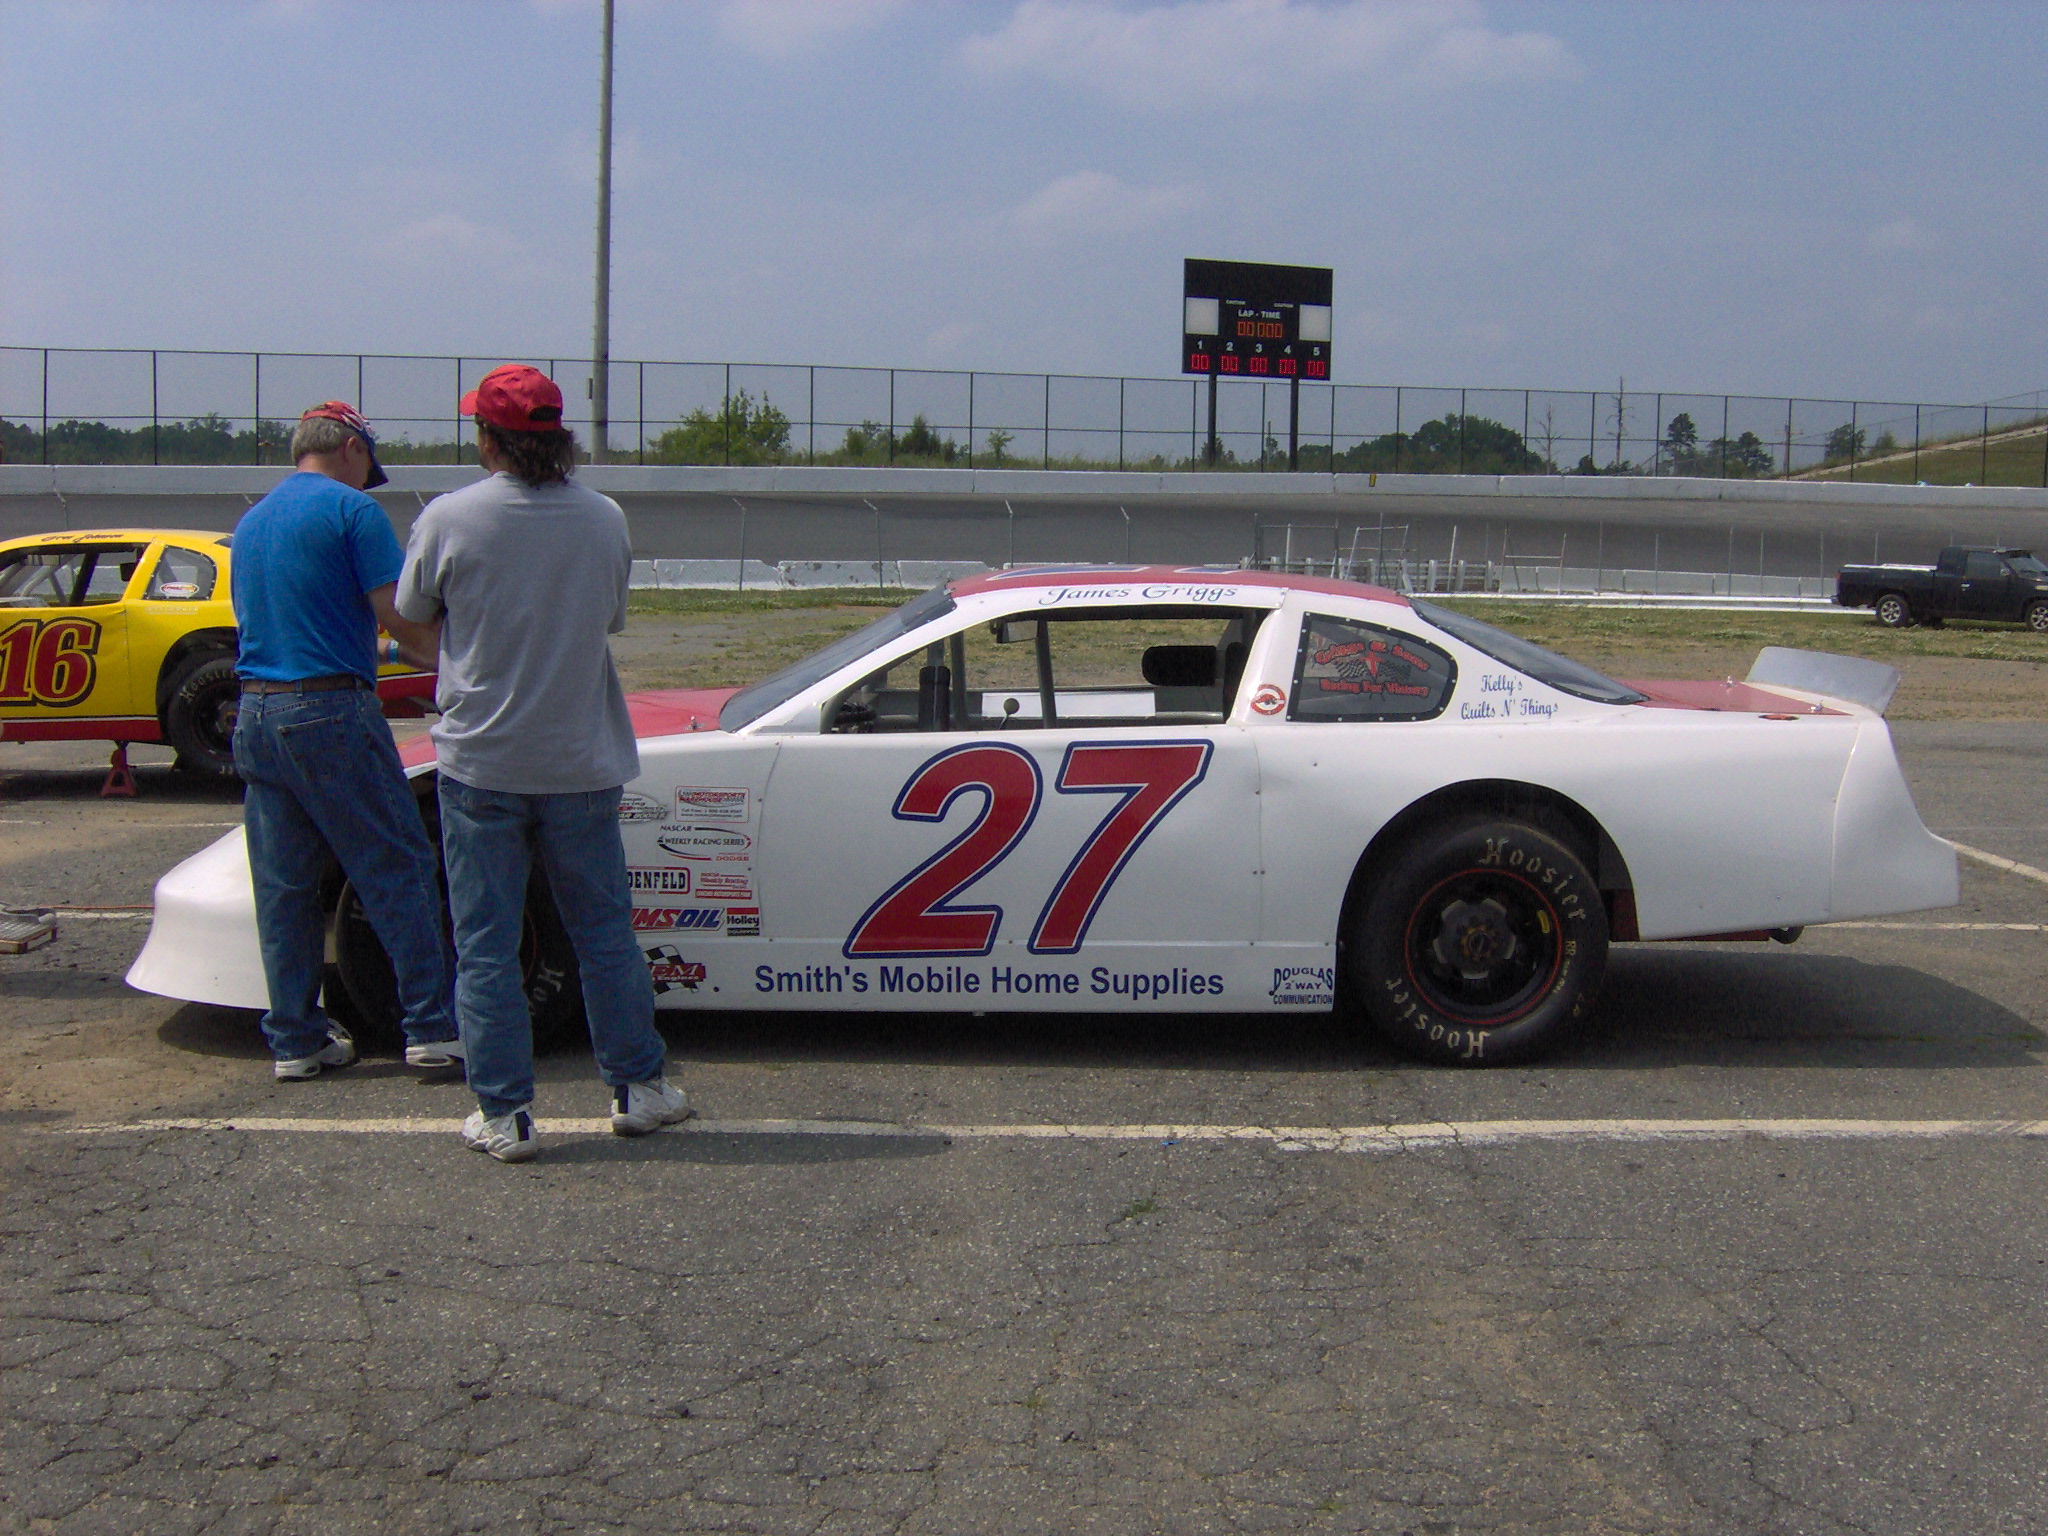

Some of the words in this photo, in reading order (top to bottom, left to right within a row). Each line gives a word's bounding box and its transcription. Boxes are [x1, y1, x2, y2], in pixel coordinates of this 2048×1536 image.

[1197, 340, 1203, 350] 1
[1226, 341, 1234, 351] 2
[1255, 343, 1263, 353] 3
[1283, 344, 1292, 355] 4
[1313, 346, 1320, 356] 5
[1038, 587, 1132, 606] James
[1142, 585, 1239, 602] Griggs
[0, 616, 101, 707] 16
[1481, 674, 1523, 696] Kelly's
[1461, 701, 1496, 720] Quilts
[1520, 698, 1559, 719] Things
[692, 838, 722, 846] RACING
[842, 739, 1215, 960] 27
[1477, 837, 1587, 921] Hoosier
[726, 915, 760, 927] Holley
[755, 964, 869, 993] Smith's
[880, 965, 981, 993] Mobile
[992, 966, 1080, 994] Home
[1090, 966, 1224, 1000] Supplies
[1273, 967, 1334, 991] DOUGLAS
[1285, 982, 1292, 990] 2
[1295, 982, 1322, 990] WAY
[1385, 977, 1492, 1058] Hoosier
